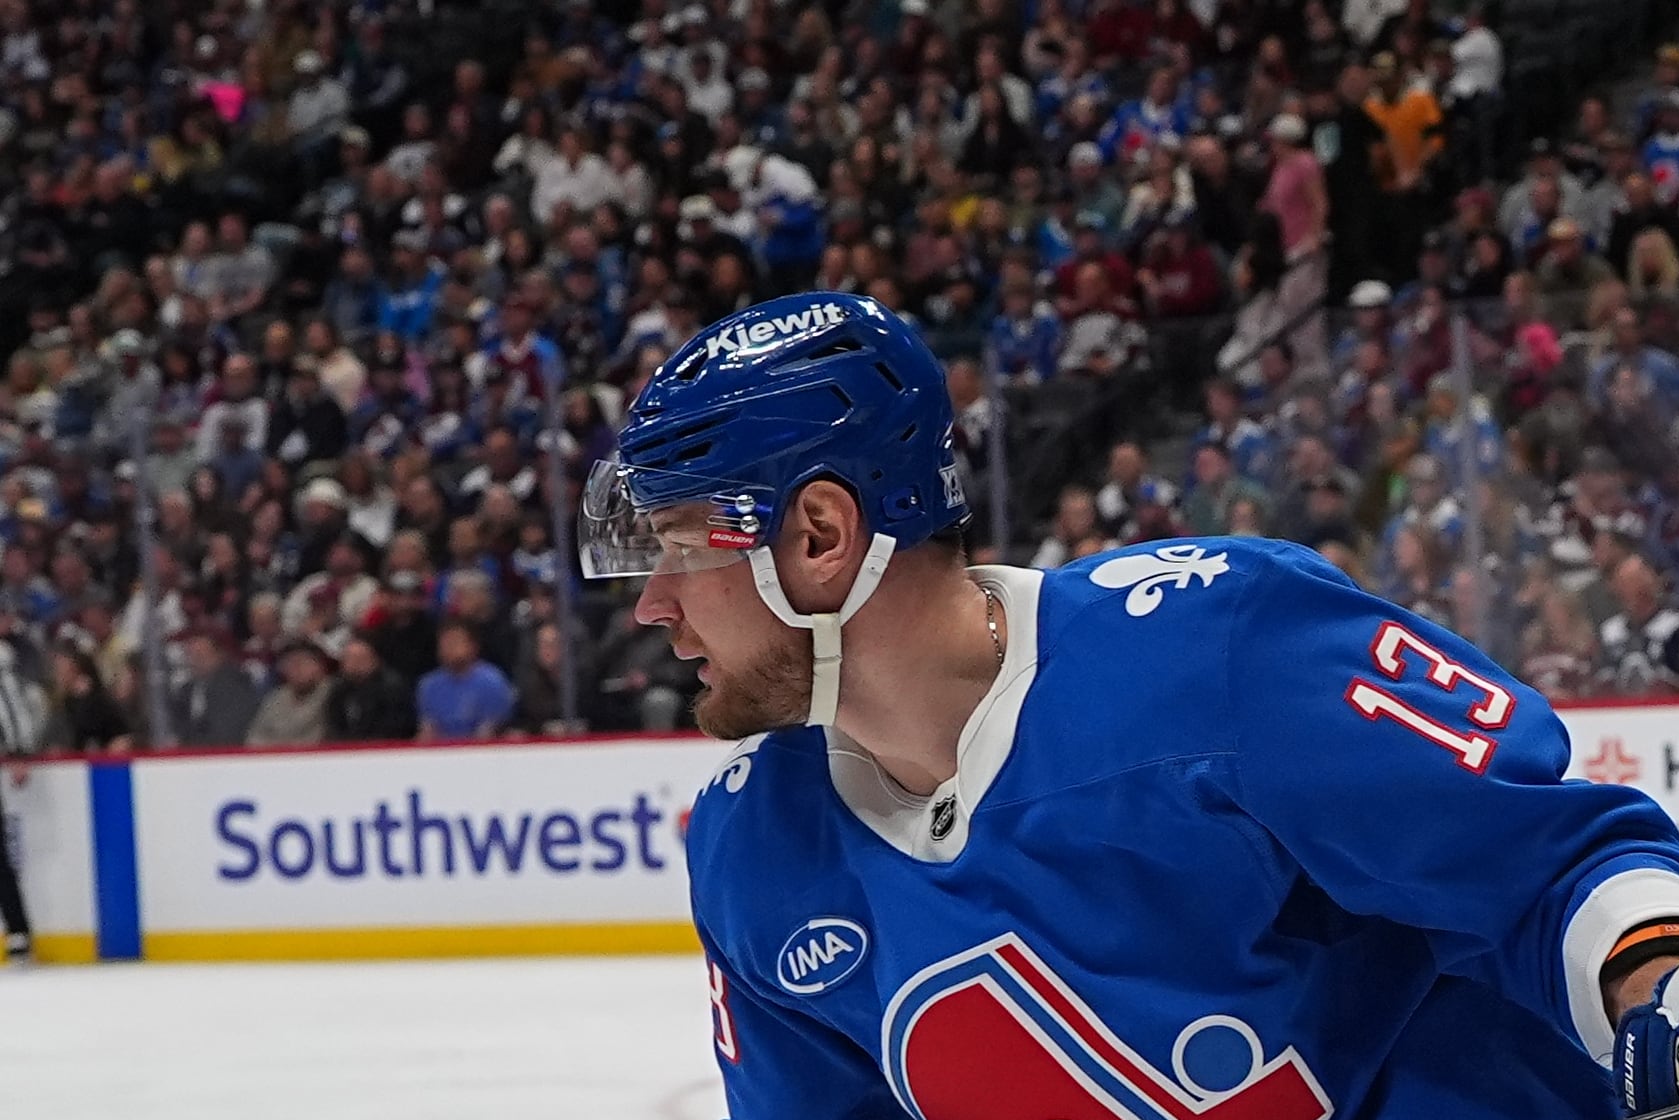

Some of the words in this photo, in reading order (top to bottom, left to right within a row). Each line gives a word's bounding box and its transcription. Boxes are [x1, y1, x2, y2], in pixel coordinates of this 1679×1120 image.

[706, 302, 844, 359] Kiewit
[1344, 619, 1517, 776] 13
[216, 788, 665, 879] Southwest
[787, 931, 855, 981] IMA
